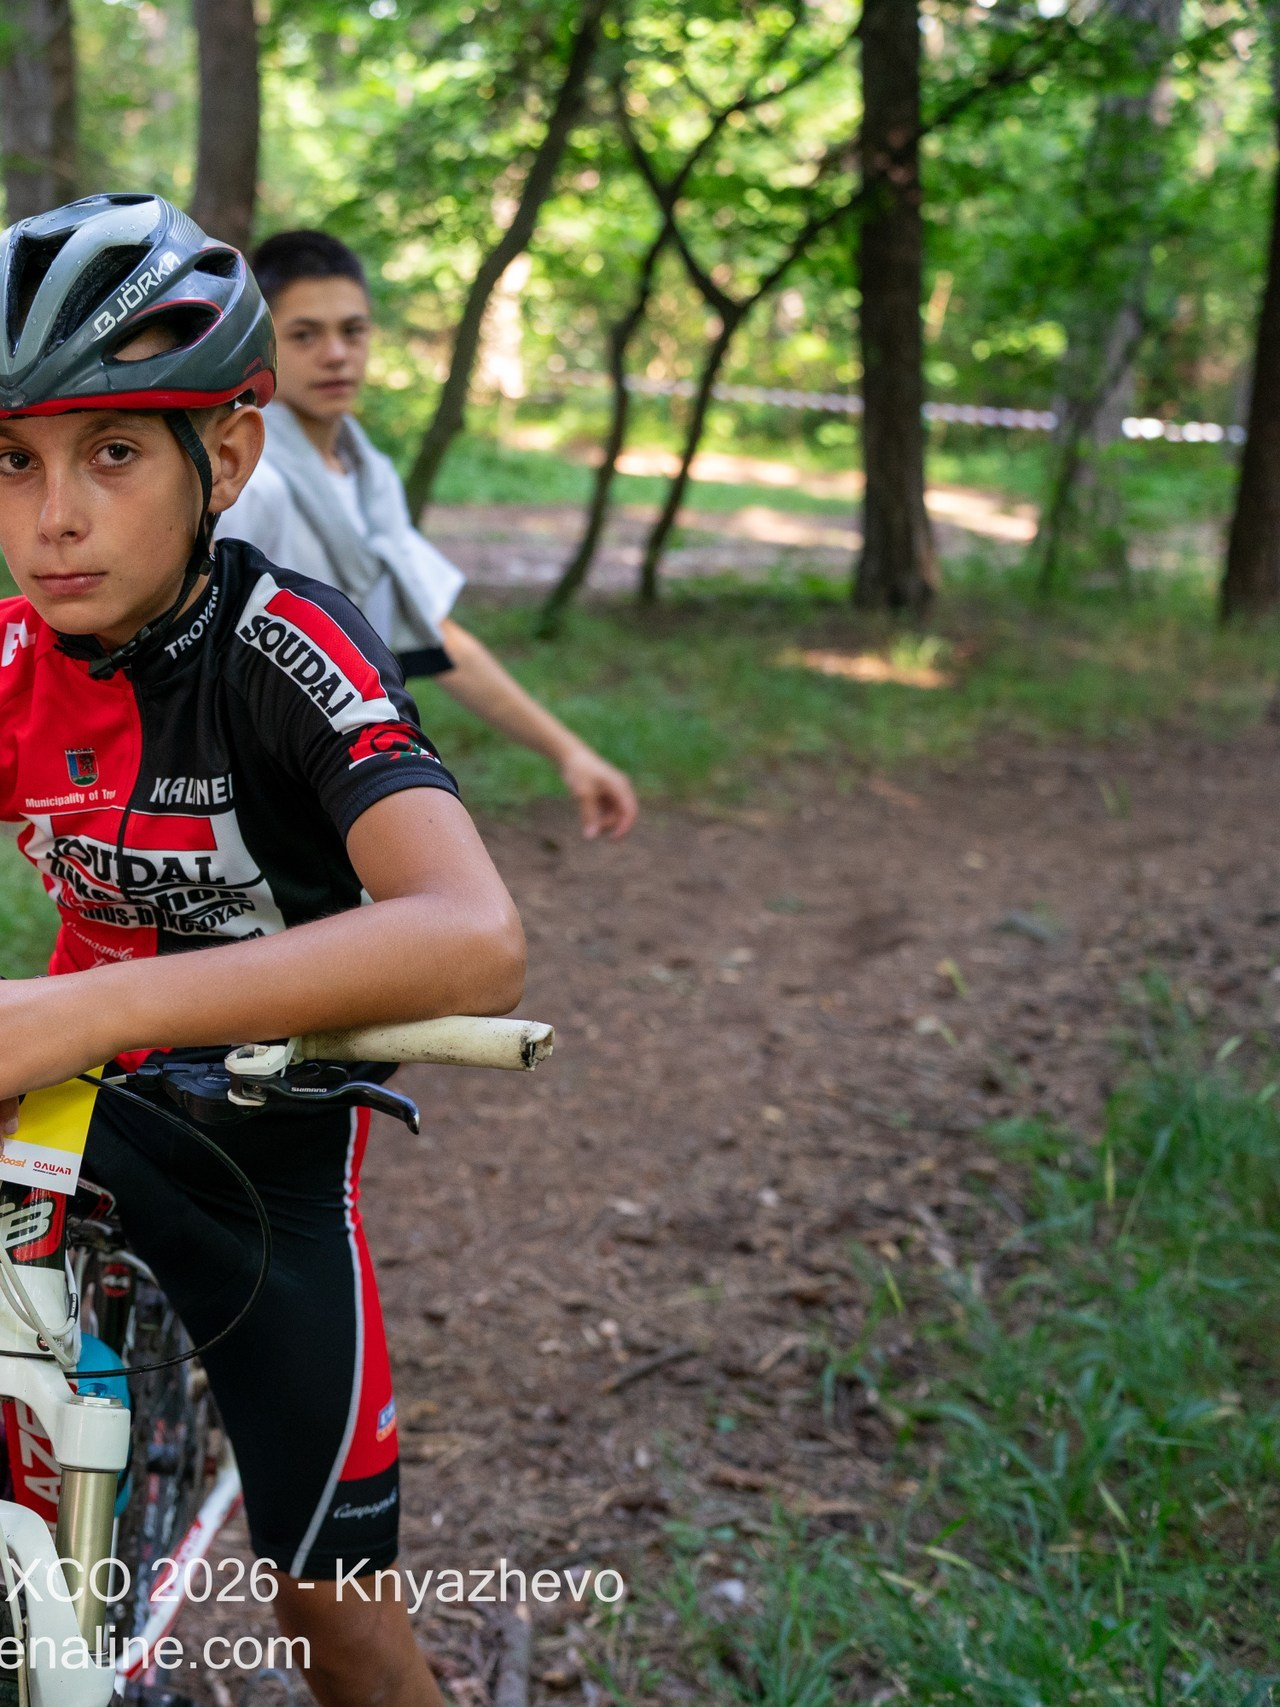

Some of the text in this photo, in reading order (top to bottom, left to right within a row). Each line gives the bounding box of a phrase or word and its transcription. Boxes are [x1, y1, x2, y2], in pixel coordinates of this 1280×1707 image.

[91, 250, 183, 343] BJÖRKA
[25, 793, 85, 808] Municipality
[88, 790, 99, 801] of
[46, 838, 227, 889] SOUDAL
